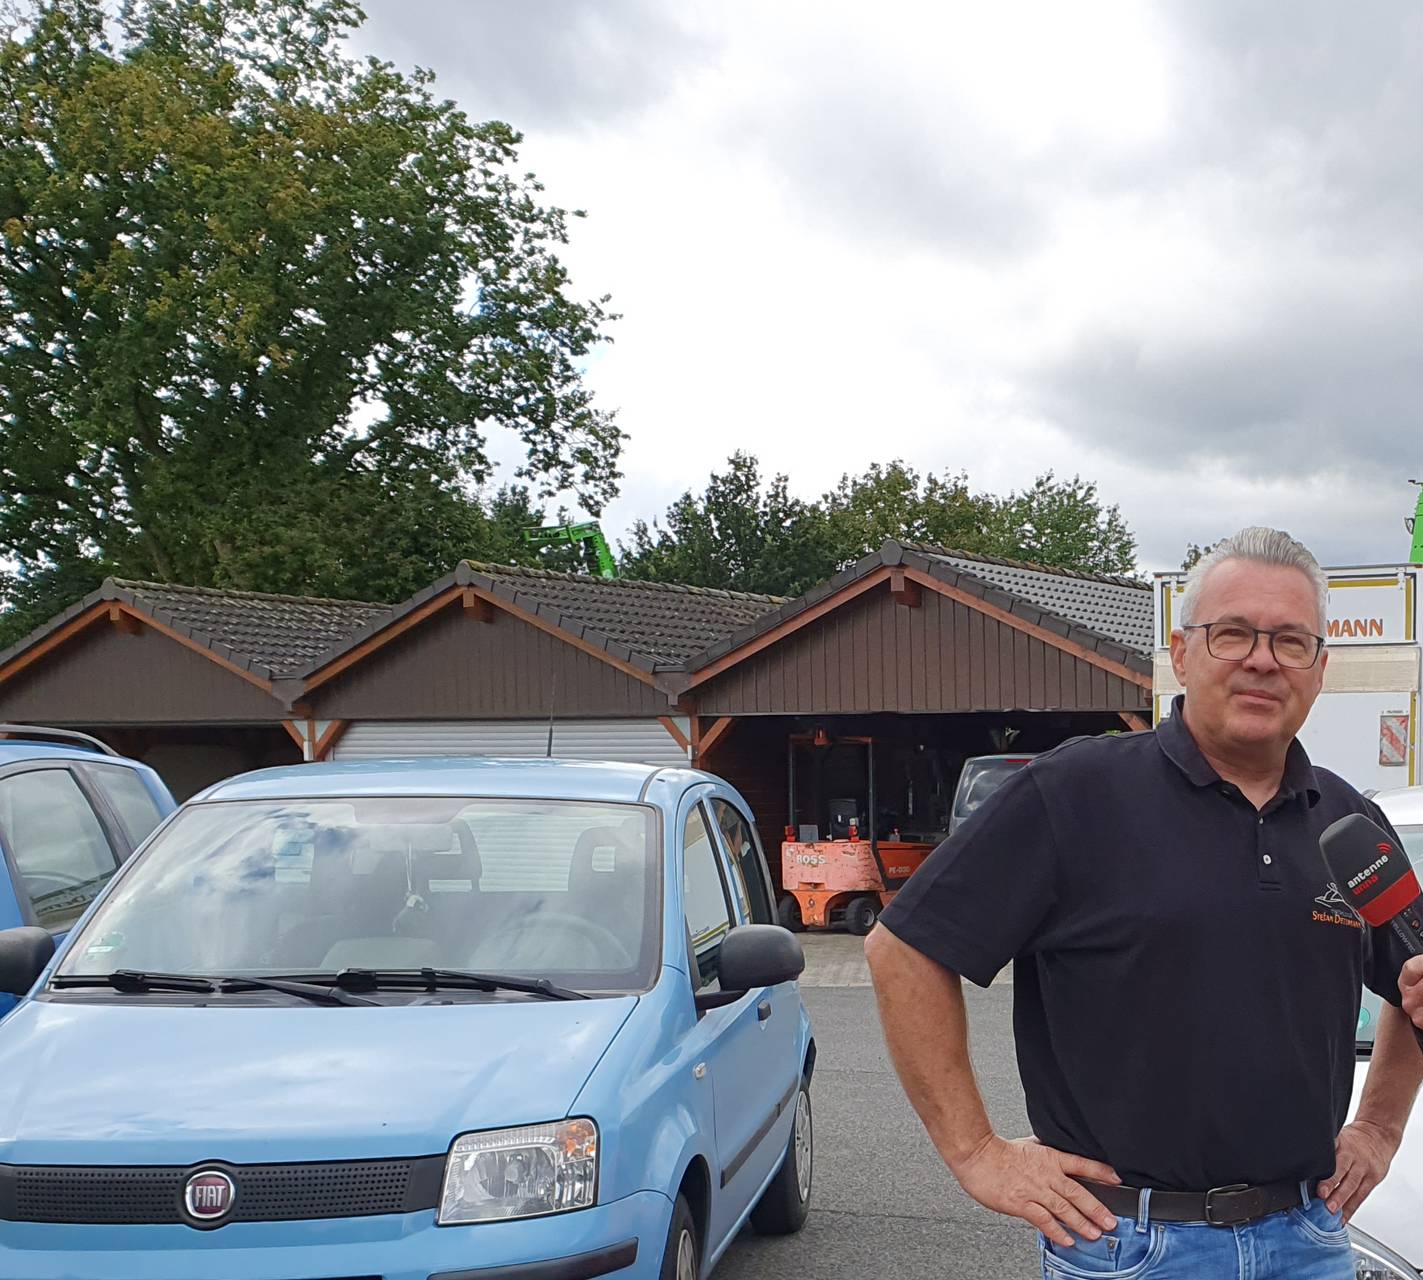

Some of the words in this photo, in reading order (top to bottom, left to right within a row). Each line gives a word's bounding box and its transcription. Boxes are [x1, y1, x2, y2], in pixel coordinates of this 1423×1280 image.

[796, 854, 826, 864] BOSS
[1347, 855, 1389, 888] antenne
[195, 1185, 226, 1207] FIAT
